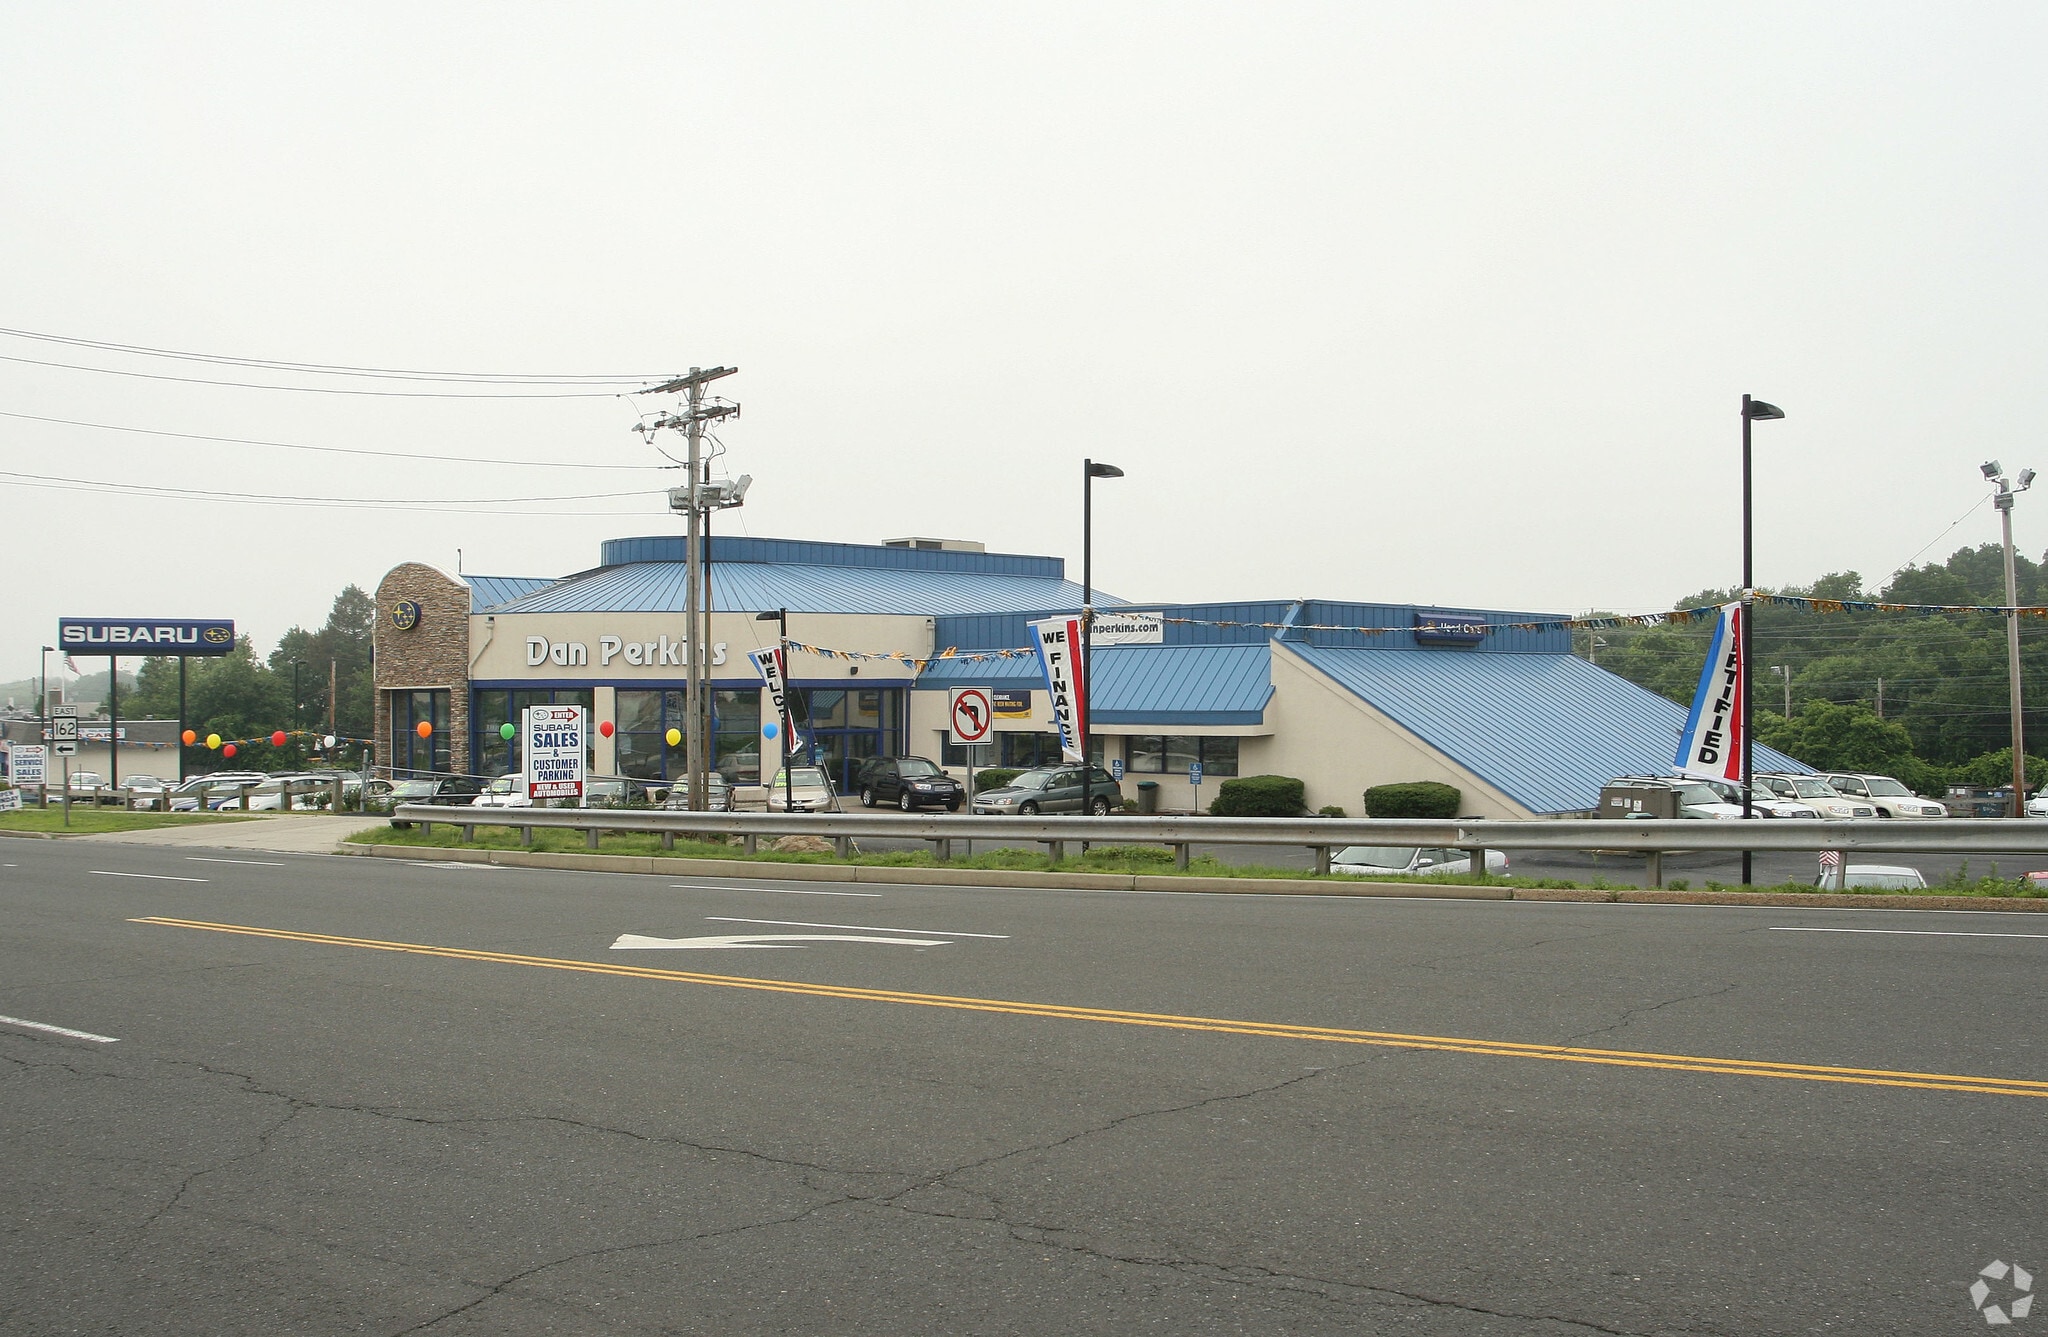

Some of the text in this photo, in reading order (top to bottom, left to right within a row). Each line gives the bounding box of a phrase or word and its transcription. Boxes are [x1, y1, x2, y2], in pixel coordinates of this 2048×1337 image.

[1091, 622, 1159, 634] nperkins.com
[63, 626, 198, 643] SUBARU
[1042, 631, 1065, 644] WE
[526, 635, 588, 666] Dan
[1050, 652, 1075, 748] FINANCE
[55, 722, 76, 736] 162
[533, 732, 579, 748] SALES
[553, 748, 559, 757] &
[533, 759, 579, 771] CUSTOMER
[16, 768, 42, 776] SALES
[538, 770, 574, 781] PARKING
[558, 782, 576, 790] USED
[533, 789, 579, 798] AUTOMOBILES
